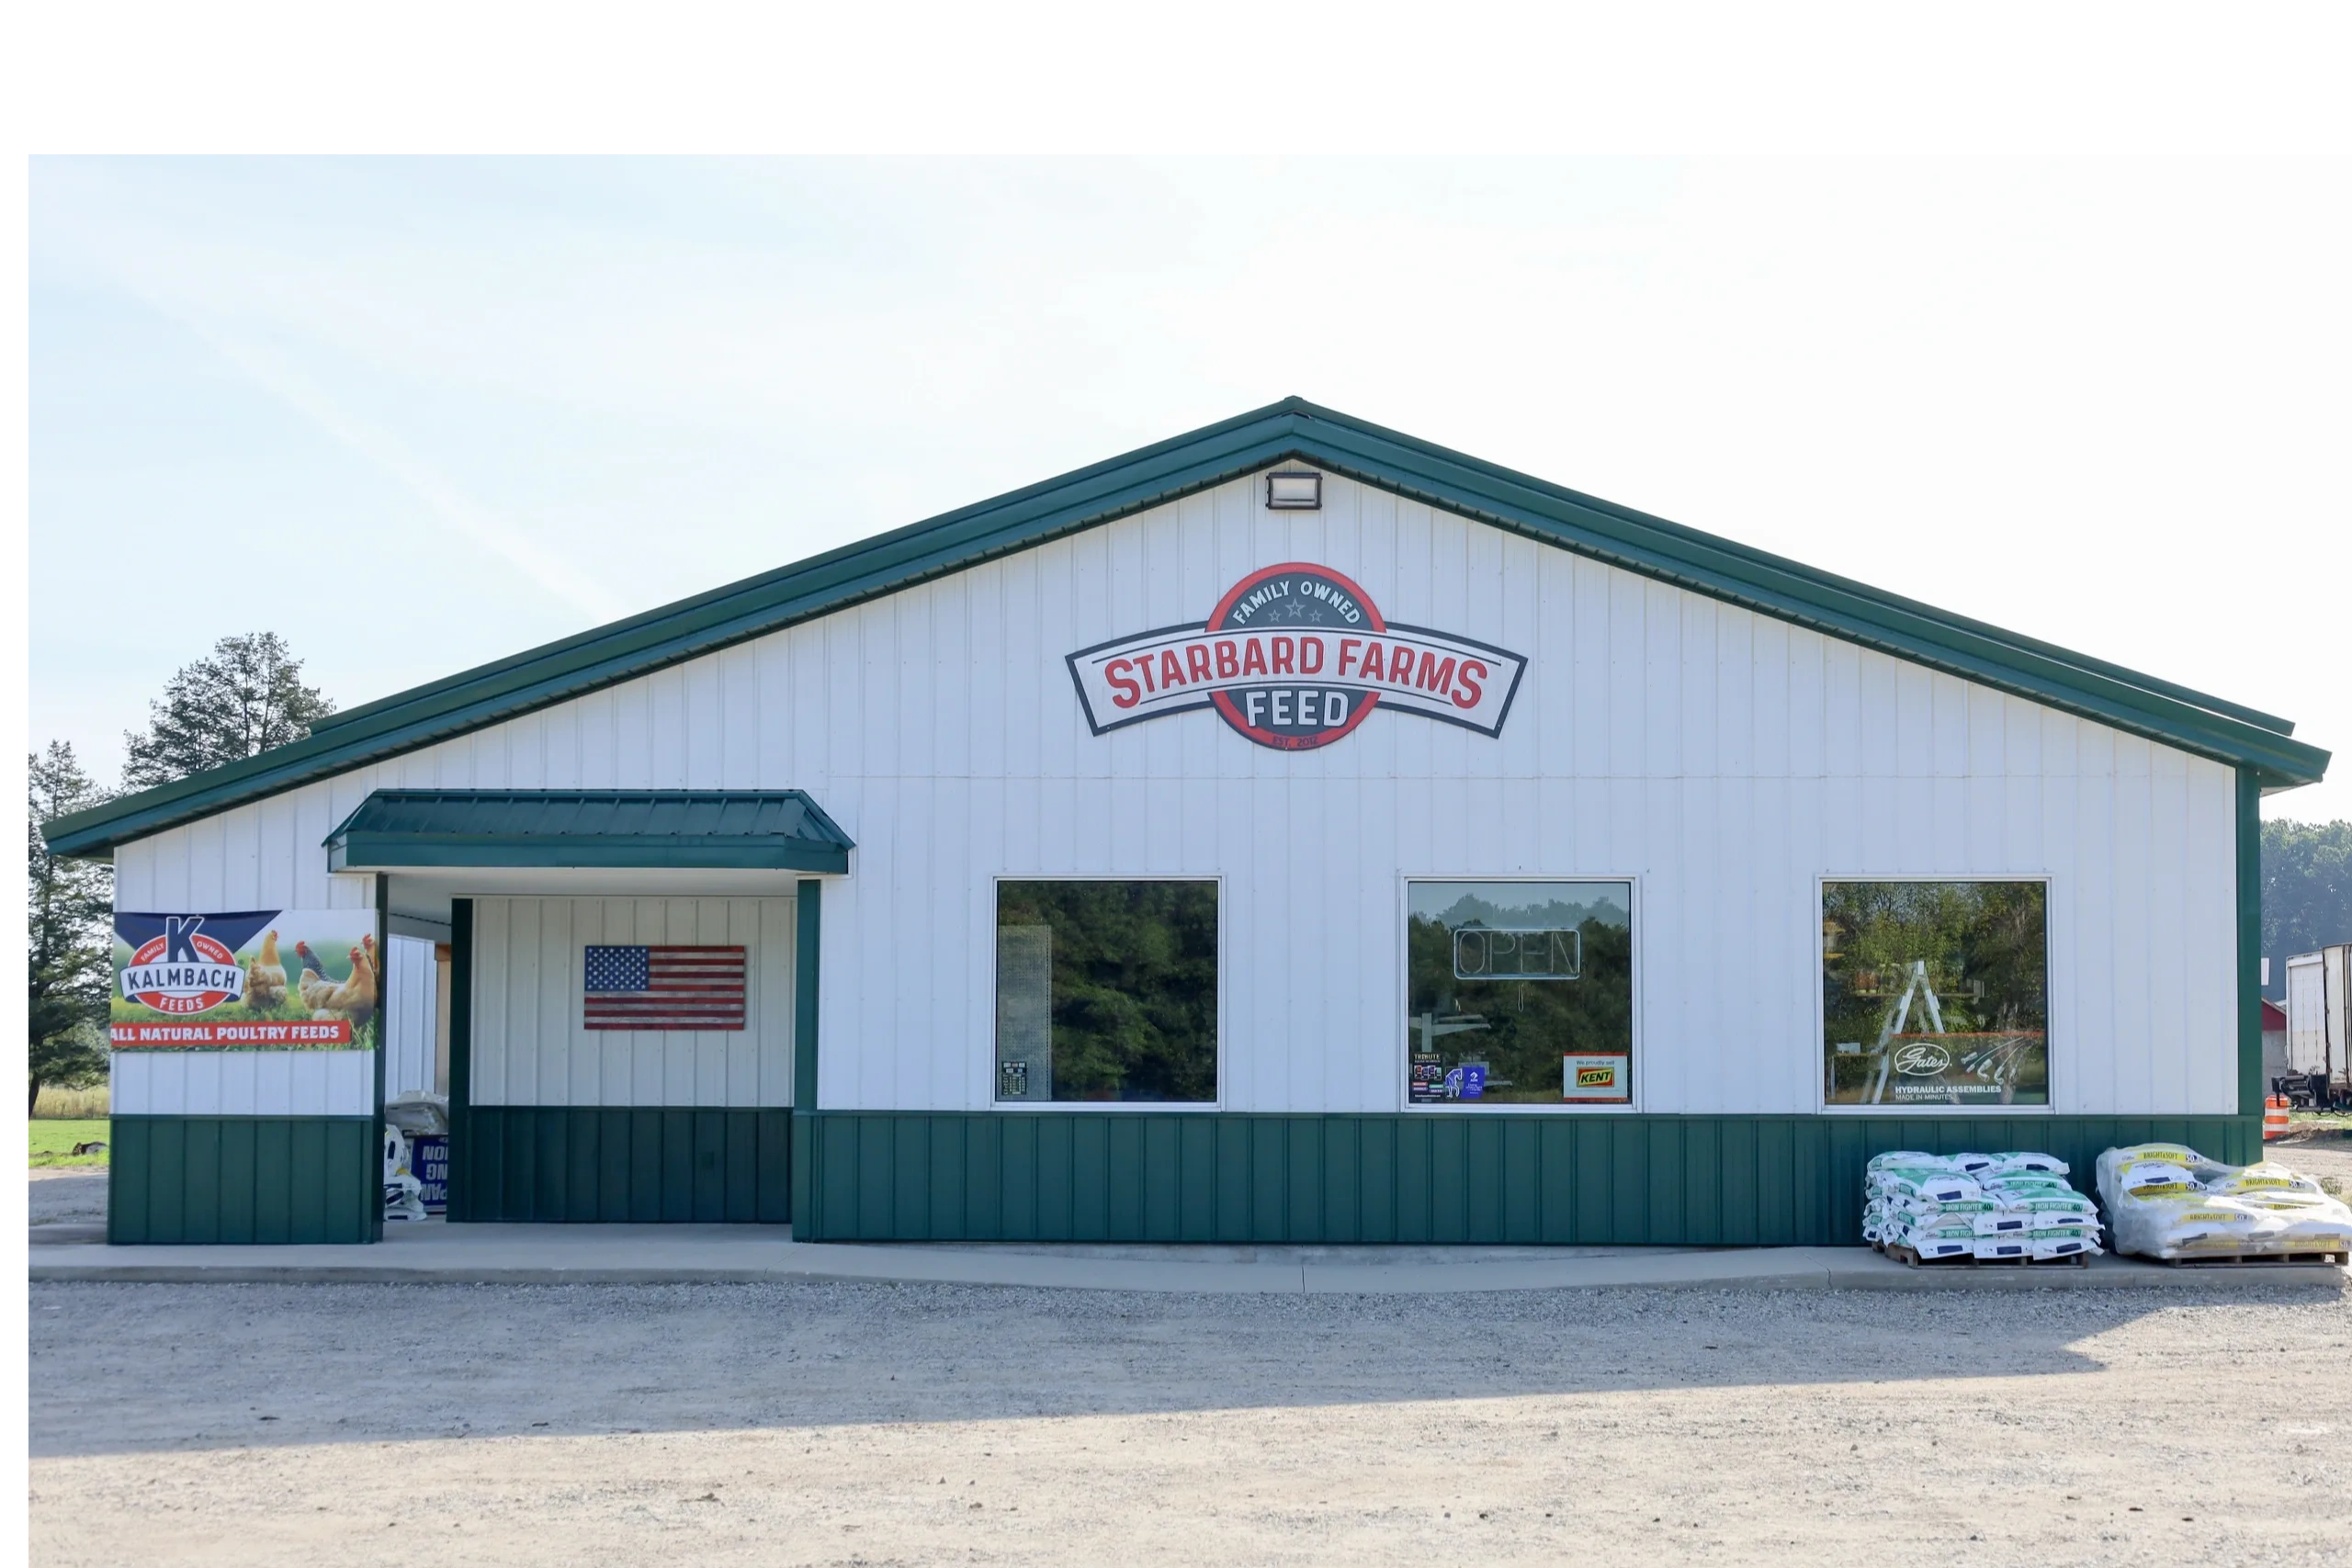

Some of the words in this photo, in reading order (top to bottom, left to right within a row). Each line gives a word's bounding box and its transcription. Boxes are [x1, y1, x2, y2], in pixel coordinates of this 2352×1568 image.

[1233, 581, 1290, 625] FAMILY
[1300, 581, 1361, 624] OWNED
[1104, 637, 1324, 709] STARBARD
[1338, 638, 1488, 709] FARMS
[1246, 690, 1349, 727] FEED
[141, 942, 165, 962] FAMILY
[196, 940, 224, 960] OWNED
[165, 916, 205, 963] K
[1458, 931, 1578, 974] OPEN
[127, 967, 237, 990] KALMBACH
[159, 998, 205, 1011] FEEDS
[109, 1027, 135, 1041] ALL
[140, 1027, 212, 1041] NATURAL
[217, 1025, 287, 1040] POULTRY
[291, 1025, 340, 1039] FEEDS
[1897, 1046, 1948, 1073] Gates
[1580, 1071, 1611, 1084] KENT
[1894, 1086, 1945, 1094] HYDRAULIC
[1946, 1085, 2002, 1093] ASSEMBLIES
